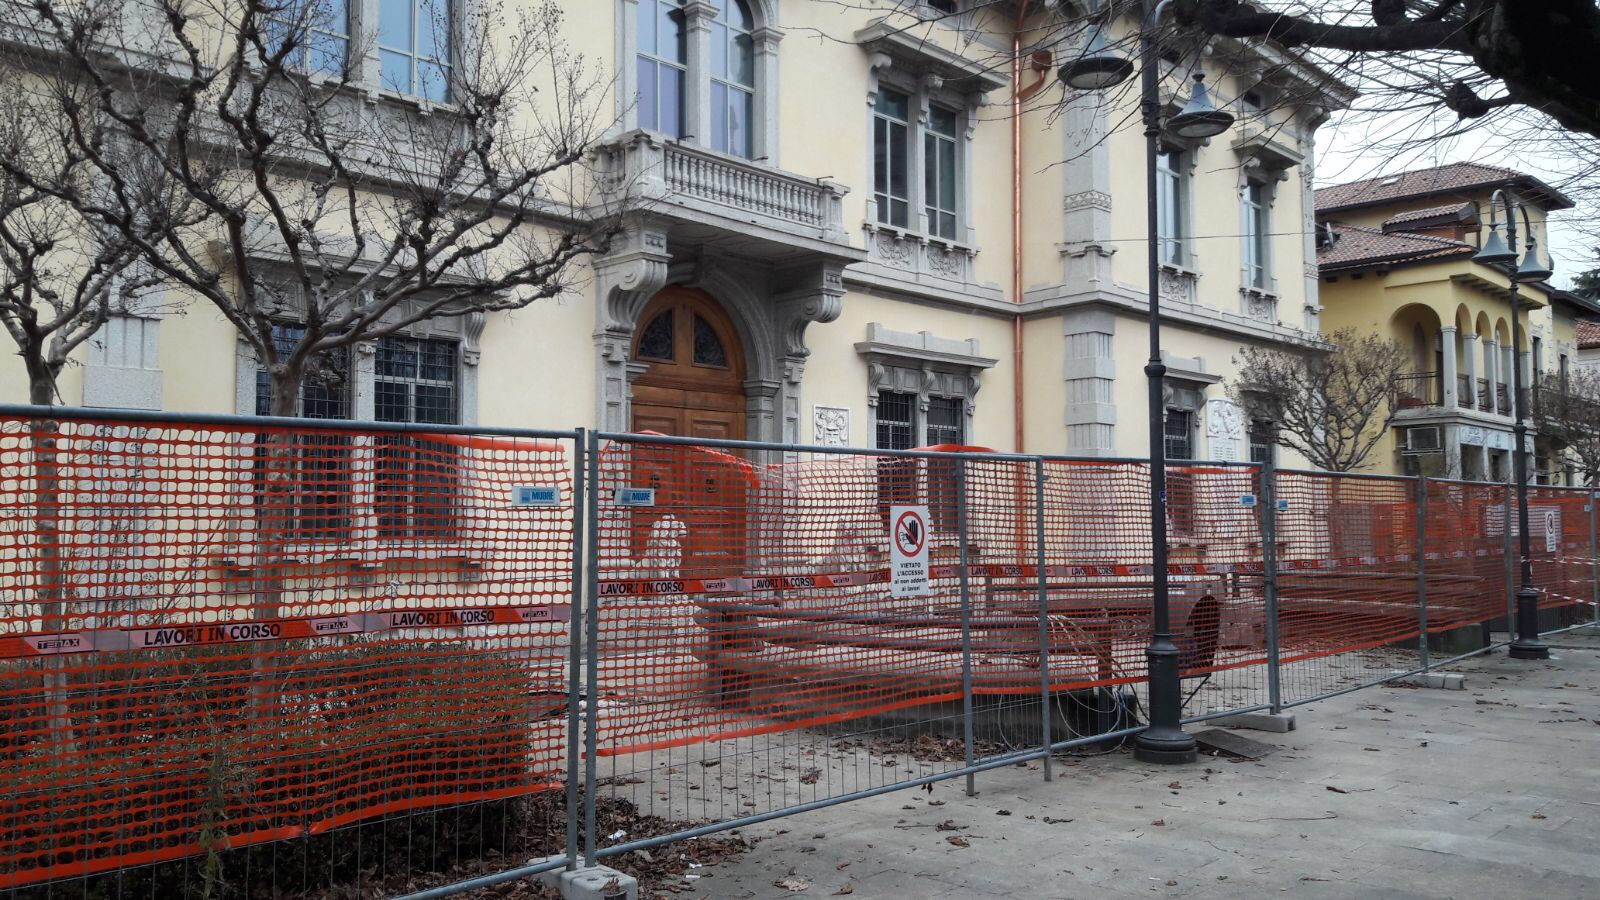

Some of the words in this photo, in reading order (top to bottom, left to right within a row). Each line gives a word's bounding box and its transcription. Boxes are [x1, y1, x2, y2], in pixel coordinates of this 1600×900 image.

[1004, 566, 1023, 575] CORSO
[600, 582, 638, 594] LAVORI
[641, 582, 655, 592] IN
[655, 581, 684, 592] CORSO
[752, 578, 778, 589] LAVORI
[780, 578, 790, 588] IN
[790, 577, 815, 588] CORSO
[391, 610, 442, 627] LAVORI
[445, 610, 459, 625] IN
[460, 609, 495, 624] CORSO
[316, 620, 349, 631] TENAX
[144, 628, 204, 646] LAVORI
[207, 627, 226, 643] IN
[230, 623, 281, 640] CORSO
[37, 639, 80, 649] TENAX
